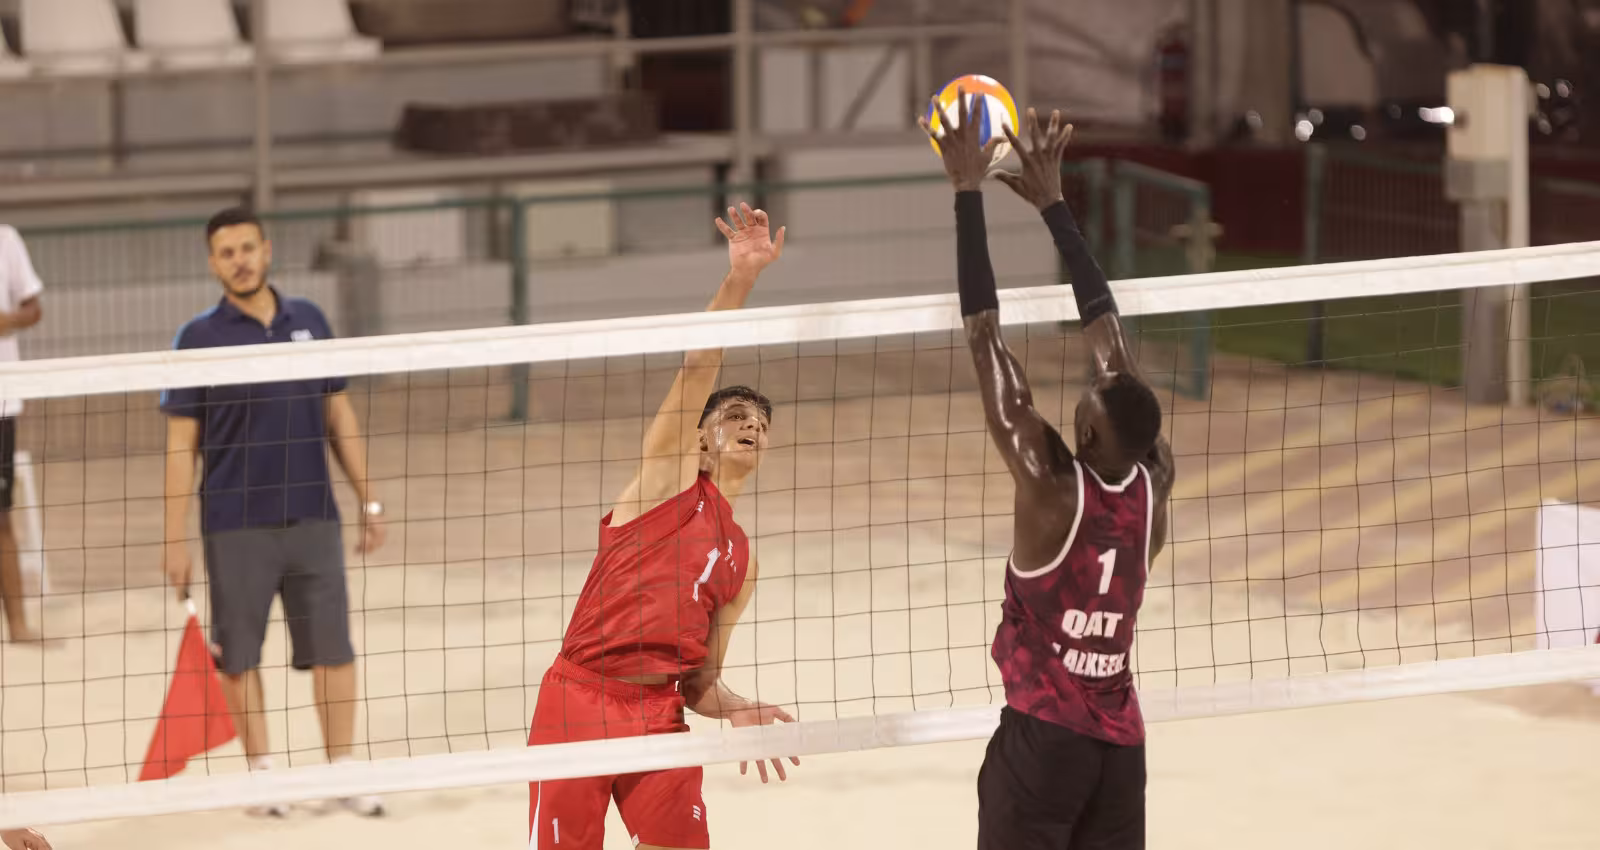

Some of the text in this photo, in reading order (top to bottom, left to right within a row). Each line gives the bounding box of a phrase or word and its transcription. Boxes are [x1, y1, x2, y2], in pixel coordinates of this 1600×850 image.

[1098, 548, 1116, 595] 1
[1061, 609, 1123, 639] QAT
[552, 817, 559, 844] 1
